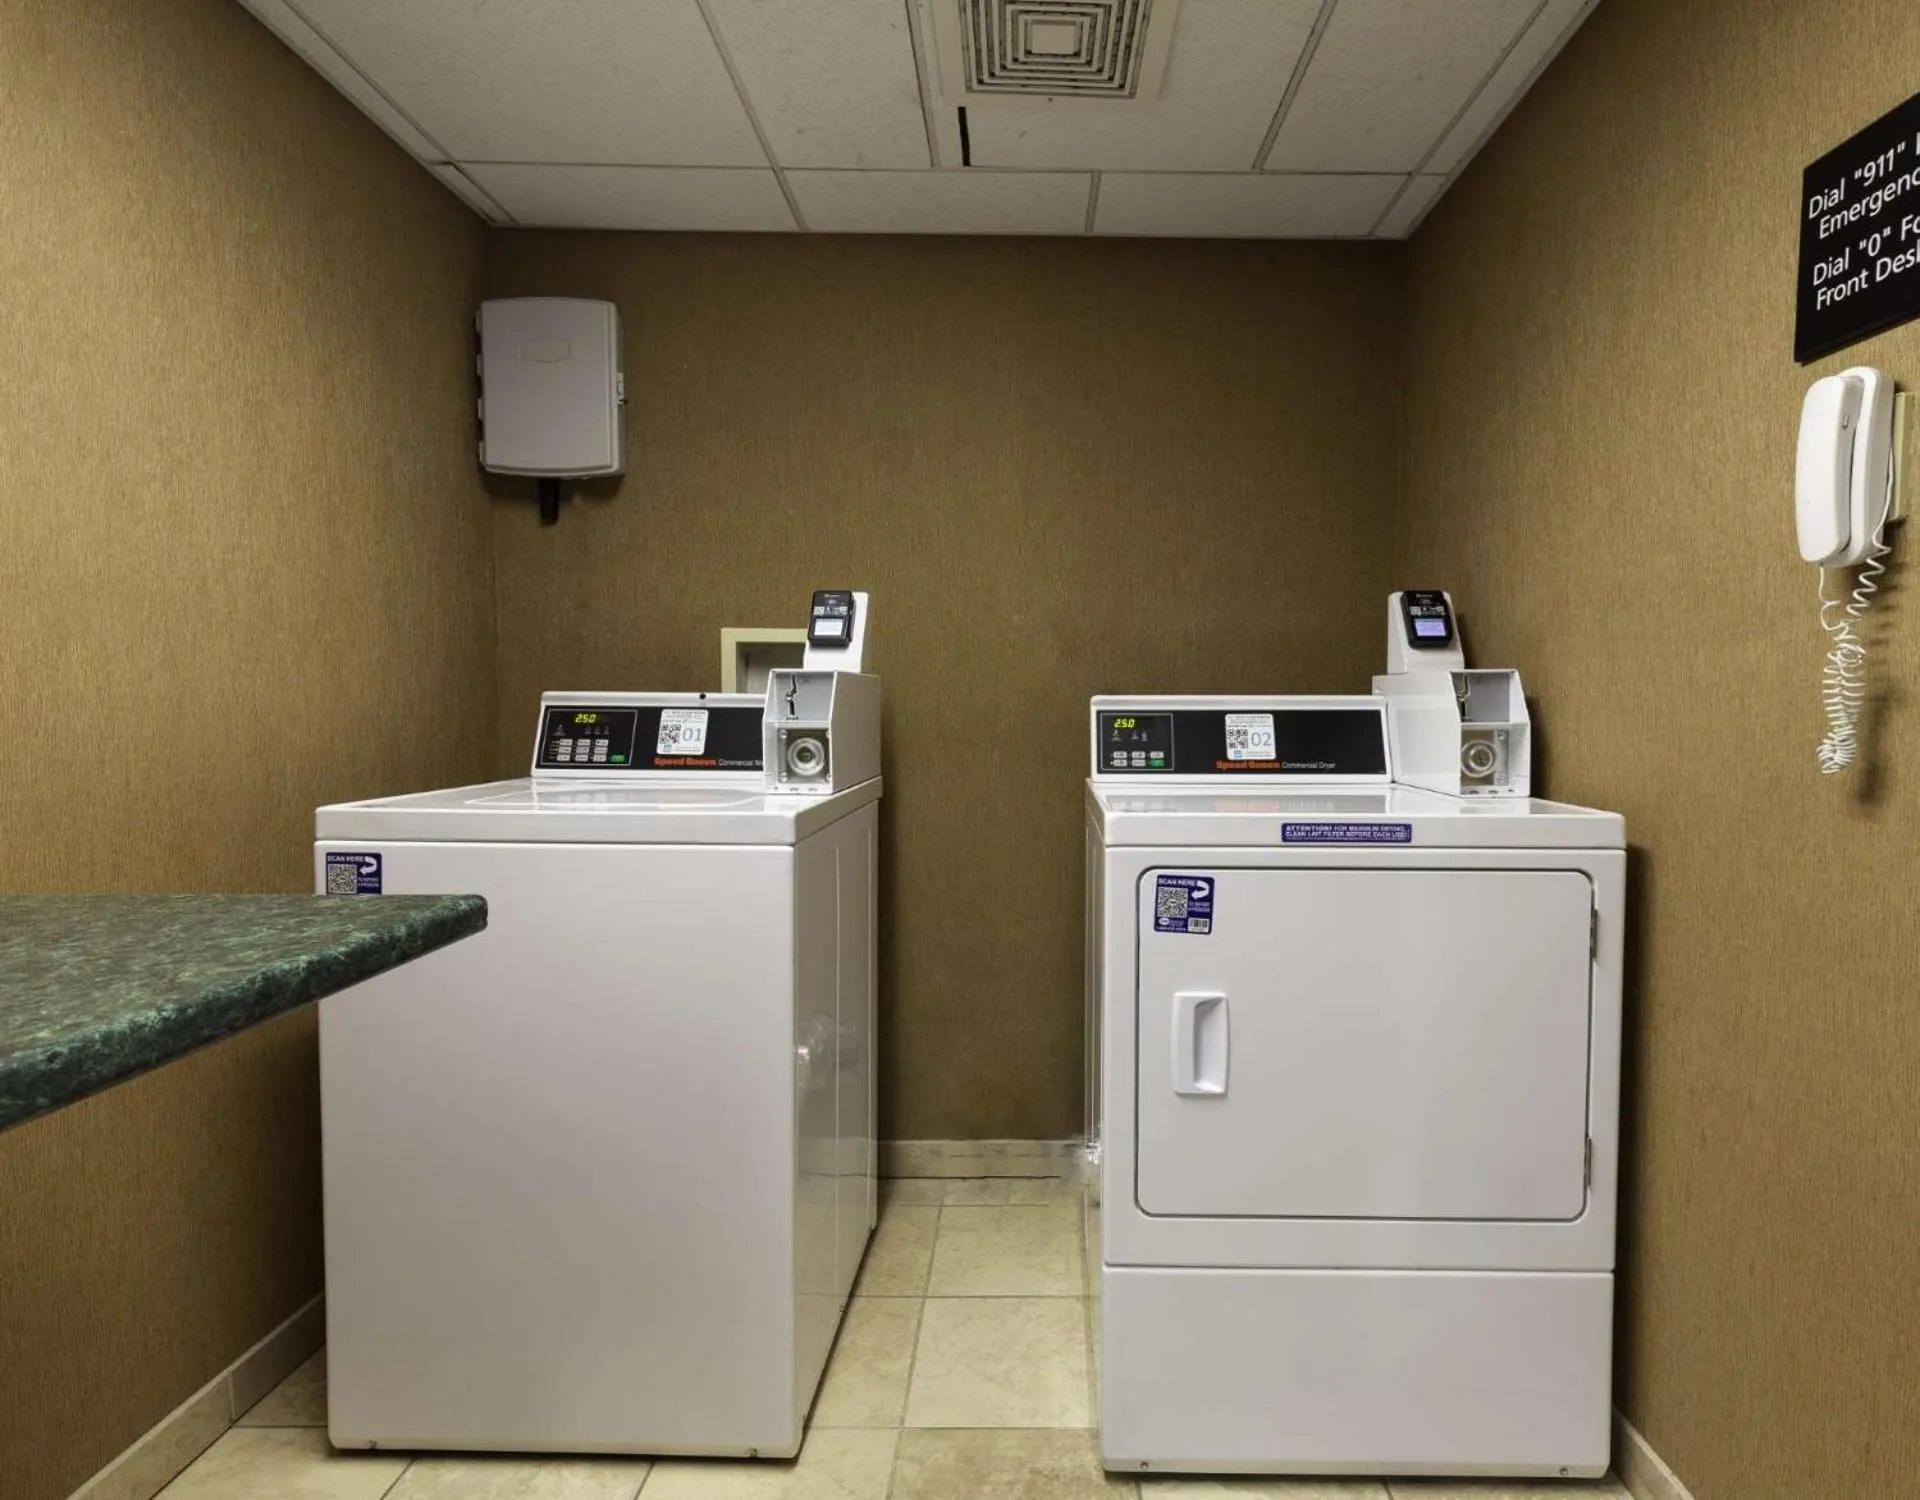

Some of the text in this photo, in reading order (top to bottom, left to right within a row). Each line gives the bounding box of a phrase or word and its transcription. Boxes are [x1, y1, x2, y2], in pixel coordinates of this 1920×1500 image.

[1808, 177, 1845, 220] Dial
[1854, 141, 1906, 187] "911"
[1813, 246, 1850, 287] Dial
[1859, 226, 1891, 257] "0"
[1816, 268, 1869, 311] Front
[682, 727, 702, 742] 01
[1251, 732, 1272, 746] 02
